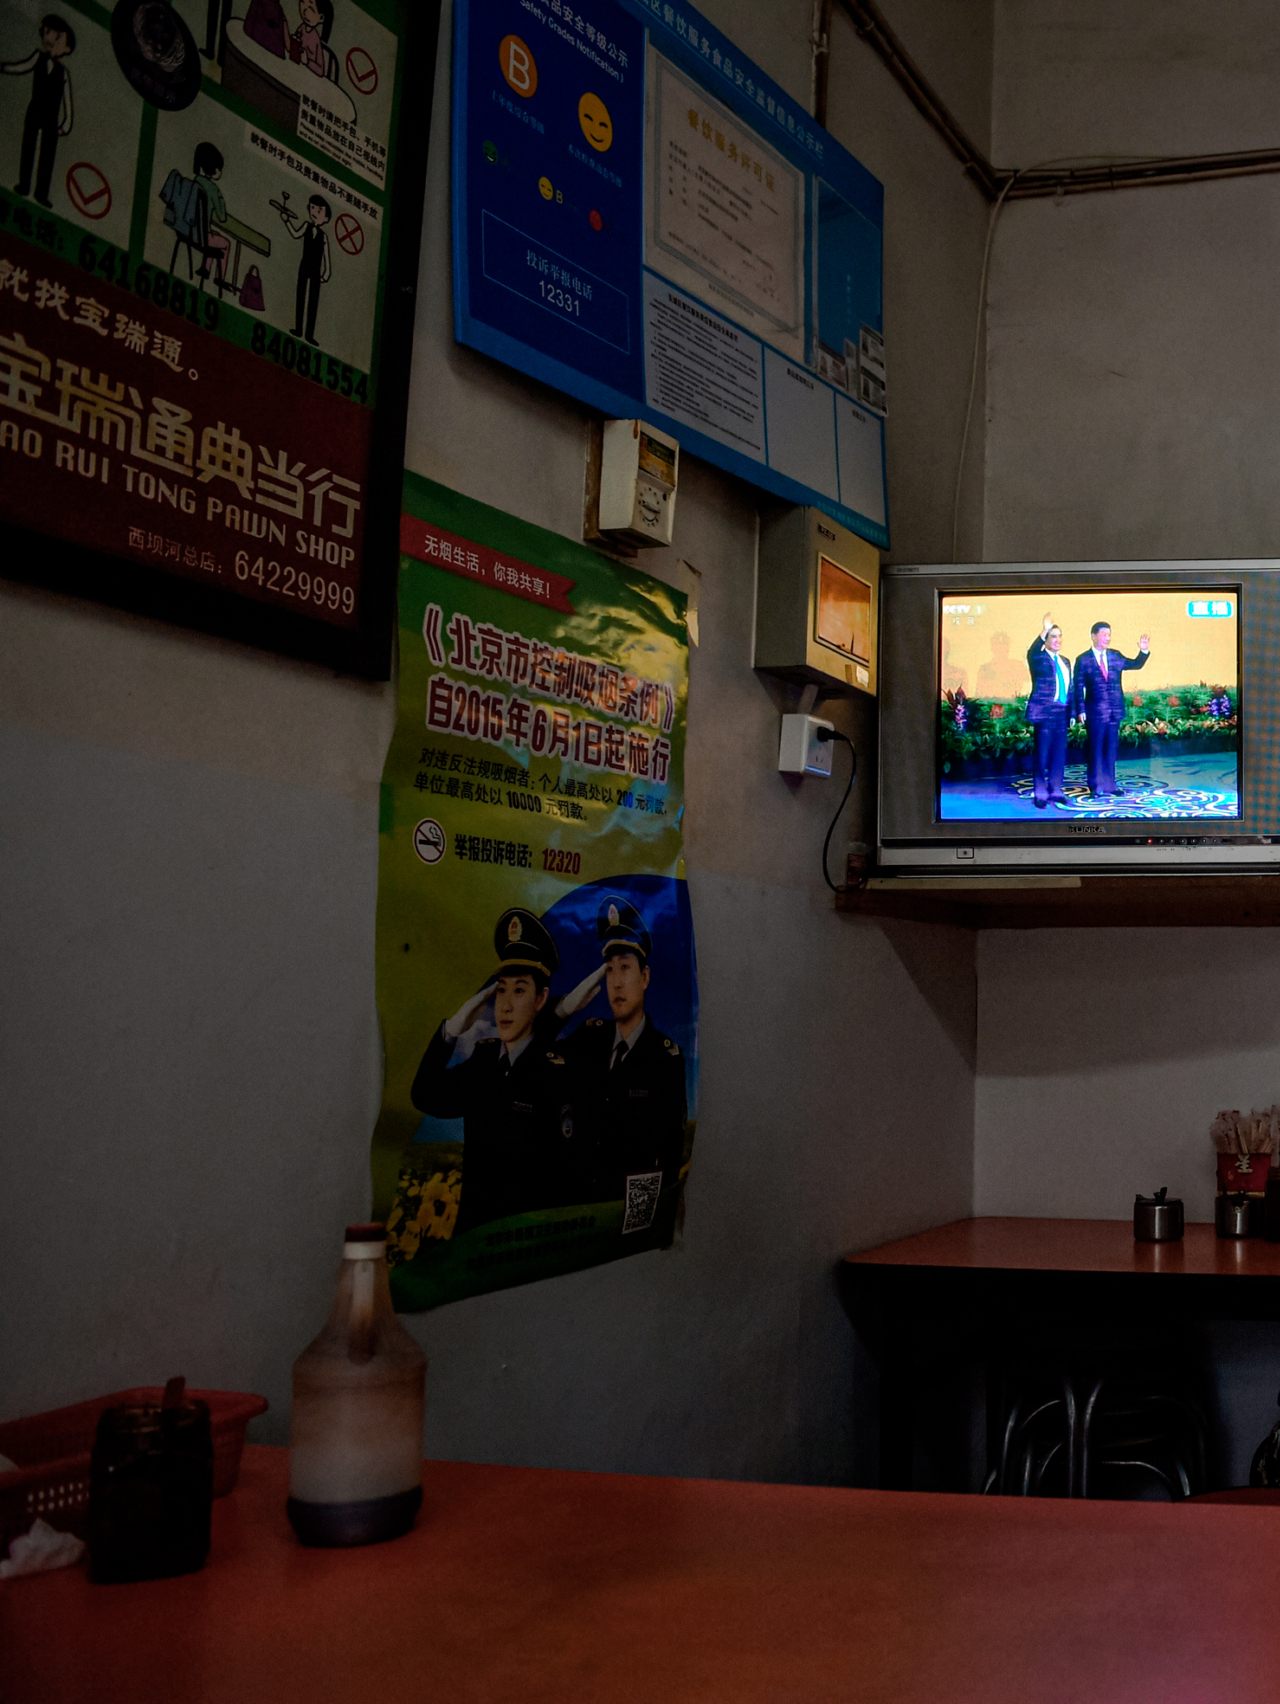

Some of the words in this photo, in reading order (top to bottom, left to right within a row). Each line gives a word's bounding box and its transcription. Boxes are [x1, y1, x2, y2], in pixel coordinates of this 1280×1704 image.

[508, 41, 530, 90] B
[548, 17, 575, 46] Grades
[638, 0, 824, 160] 区餐饮服务食品安全监督信息公示栏
[250, 132, 379, 220] 就餐时手包及贵重物品不要随手放
[687, 108, 775, 193] 餐饮服务许可证
[526, 249, 593, 301] 投诉举报电话
[538, 279, 580, 317] 12331
[78, 235, 219, 332] 64168819
[251, 321, 369, 405] 84081554
[0, 331, 361, 539] 宝瑞通典当行
[56, 441, 109, 485] RUI
[122, 463, 197, 515] TONG
[207, 496, 287, 548] PAWN
[296, 530, 355, 570] SHOP
[128, 525, 222, 575] 西坝河总店：
[234, 549, 355, 616] 64229999
[424, 534, 551, 599] 无烟生活，你我共享！
[1192, 602, 1229, 616] 直播
[425, 604, 675, 732] 《北京市控制吸烟条例》
[427, 677, 672, 782] 自2015年6月1日起施行
[506, 790, 541, 814] 10000
[455, 832, 532, 869] 举报投诉电话：
[542, 848, 580, 875] 12320
